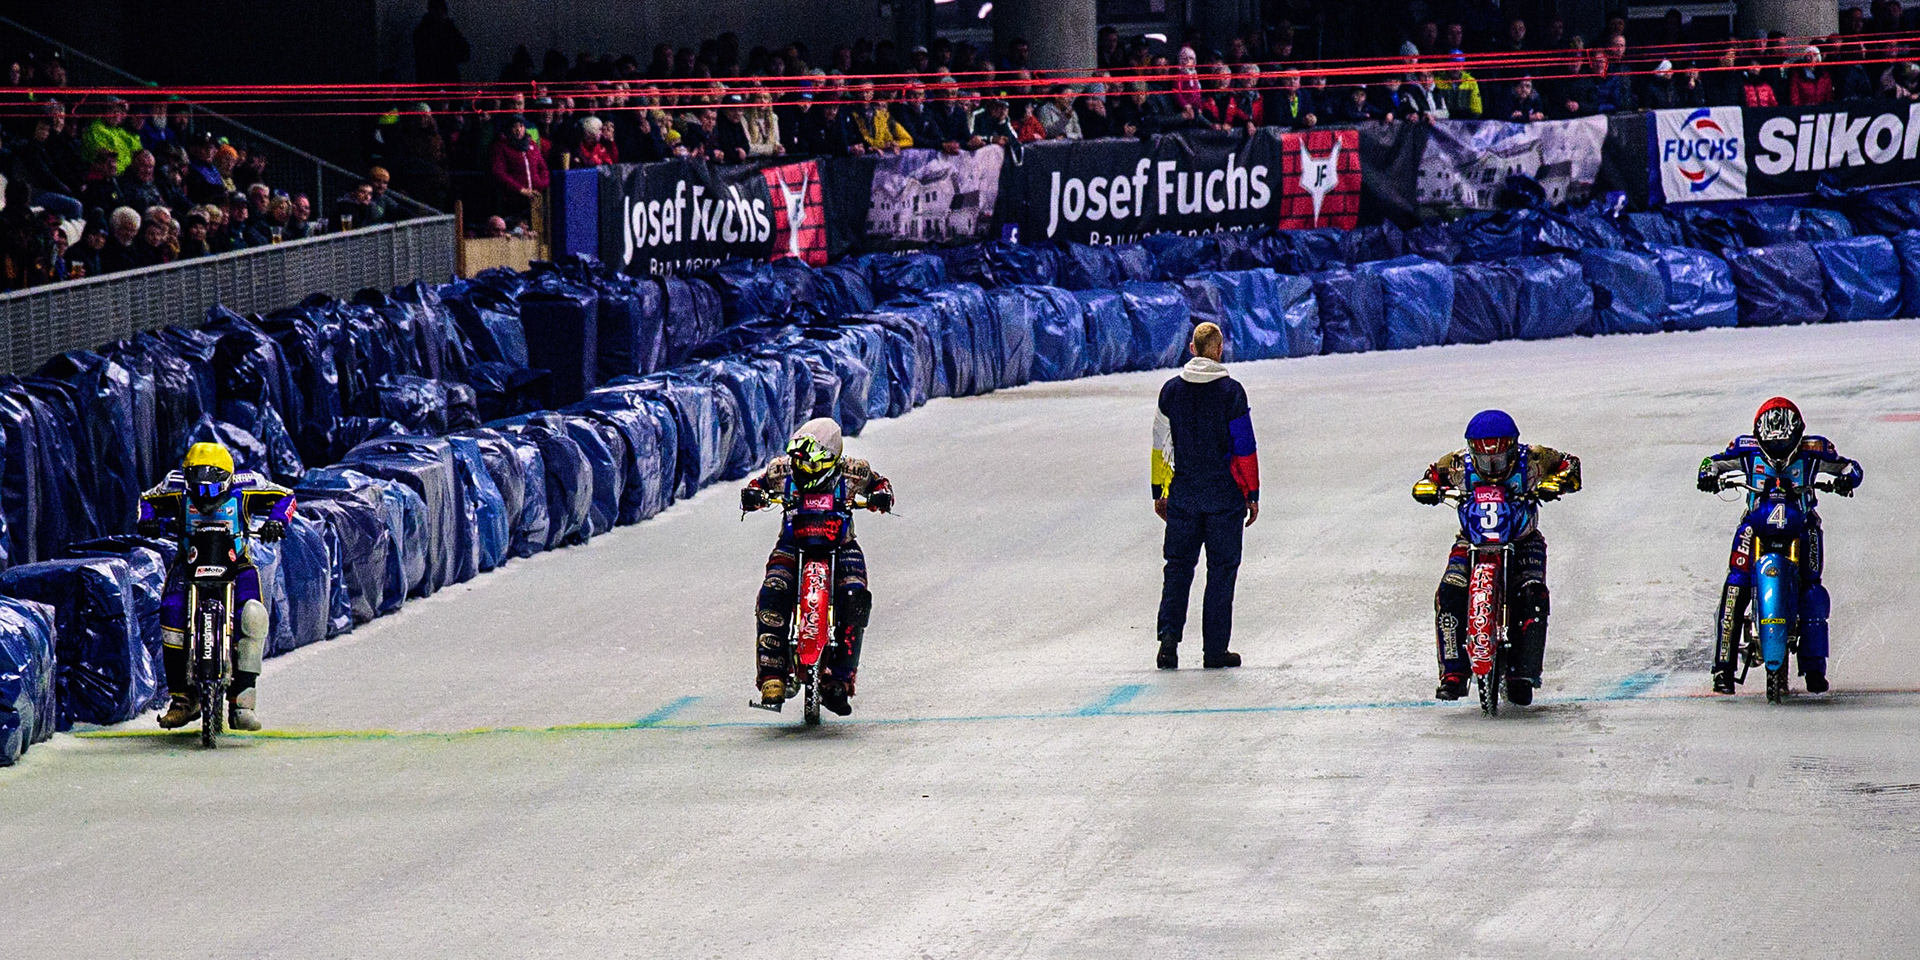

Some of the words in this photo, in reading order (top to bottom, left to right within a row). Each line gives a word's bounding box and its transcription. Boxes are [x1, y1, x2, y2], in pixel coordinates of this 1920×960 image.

[1663, 138, 1738, 162] FUCHS
[1314, 164, 1327, 187] JF
[1047, 158, 1150, 238] Josef
[1157, 153, 1271, 216] Fuchs
[623, 180, 686, 265] Josef
[690, 185, 770, 242] Fuchs
[1480, 502, 1498, 529] 3
[1766, 503, 1788, 529] 4
[1738, 525, 1754, 555] Enke
